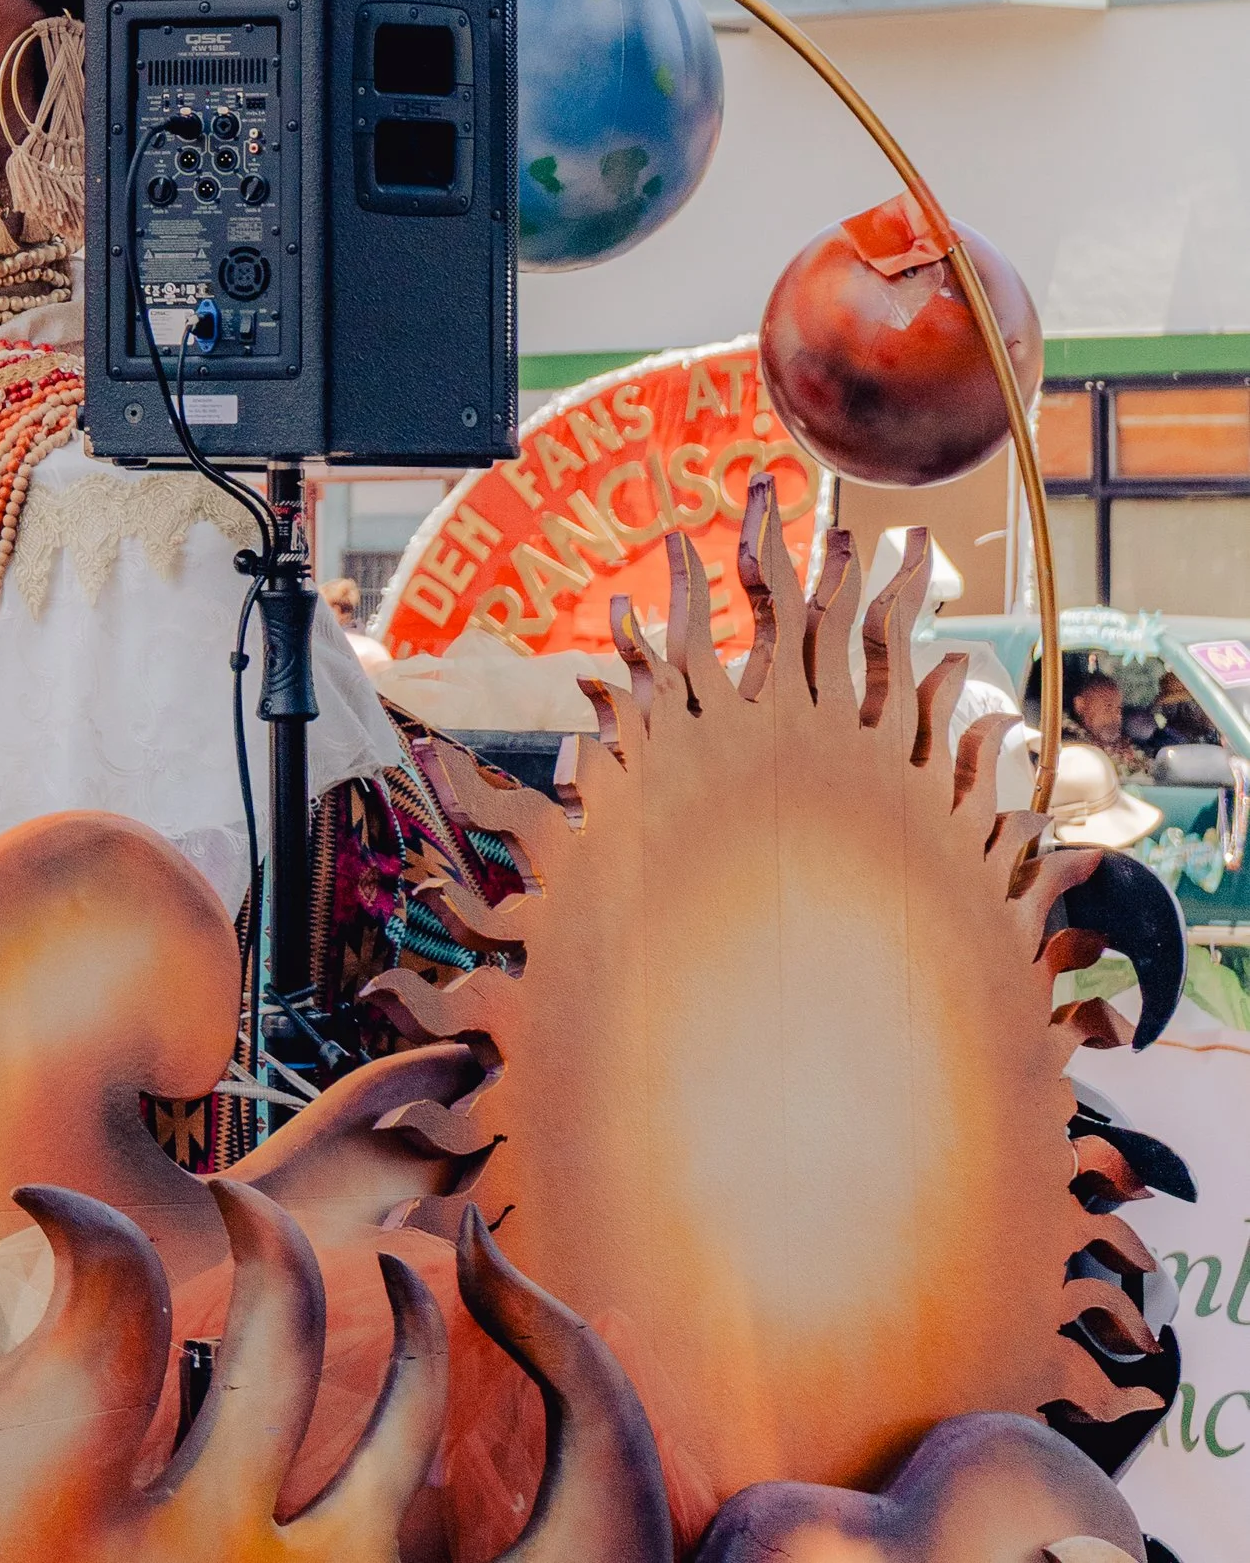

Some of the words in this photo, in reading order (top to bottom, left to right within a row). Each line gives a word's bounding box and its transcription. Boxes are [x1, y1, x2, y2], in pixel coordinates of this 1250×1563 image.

[185, 34, 232, 45] QSC
[500, 385, 654, 510] FANS
[685, 359, 772, 422] AT
[468, 439, 820, 657] RANCISCO
